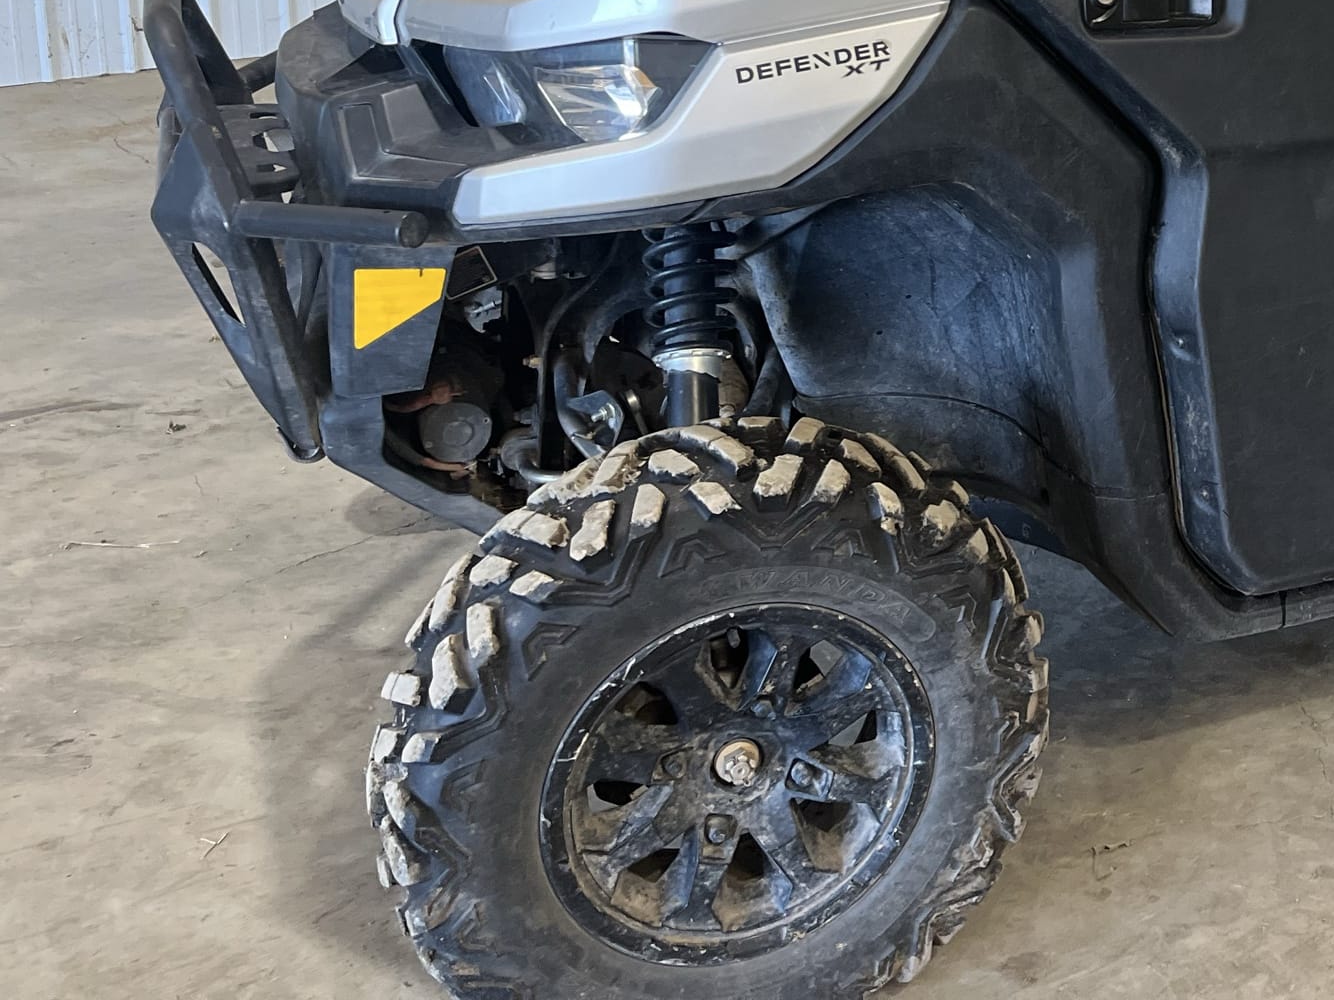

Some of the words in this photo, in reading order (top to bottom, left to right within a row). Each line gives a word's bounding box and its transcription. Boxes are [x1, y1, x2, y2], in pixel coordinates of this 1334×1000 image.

[735, 41, 891, 84] DEFENDER
[842, 58, 890, 78] XT
[737, 569, 913, 626] WANDA
